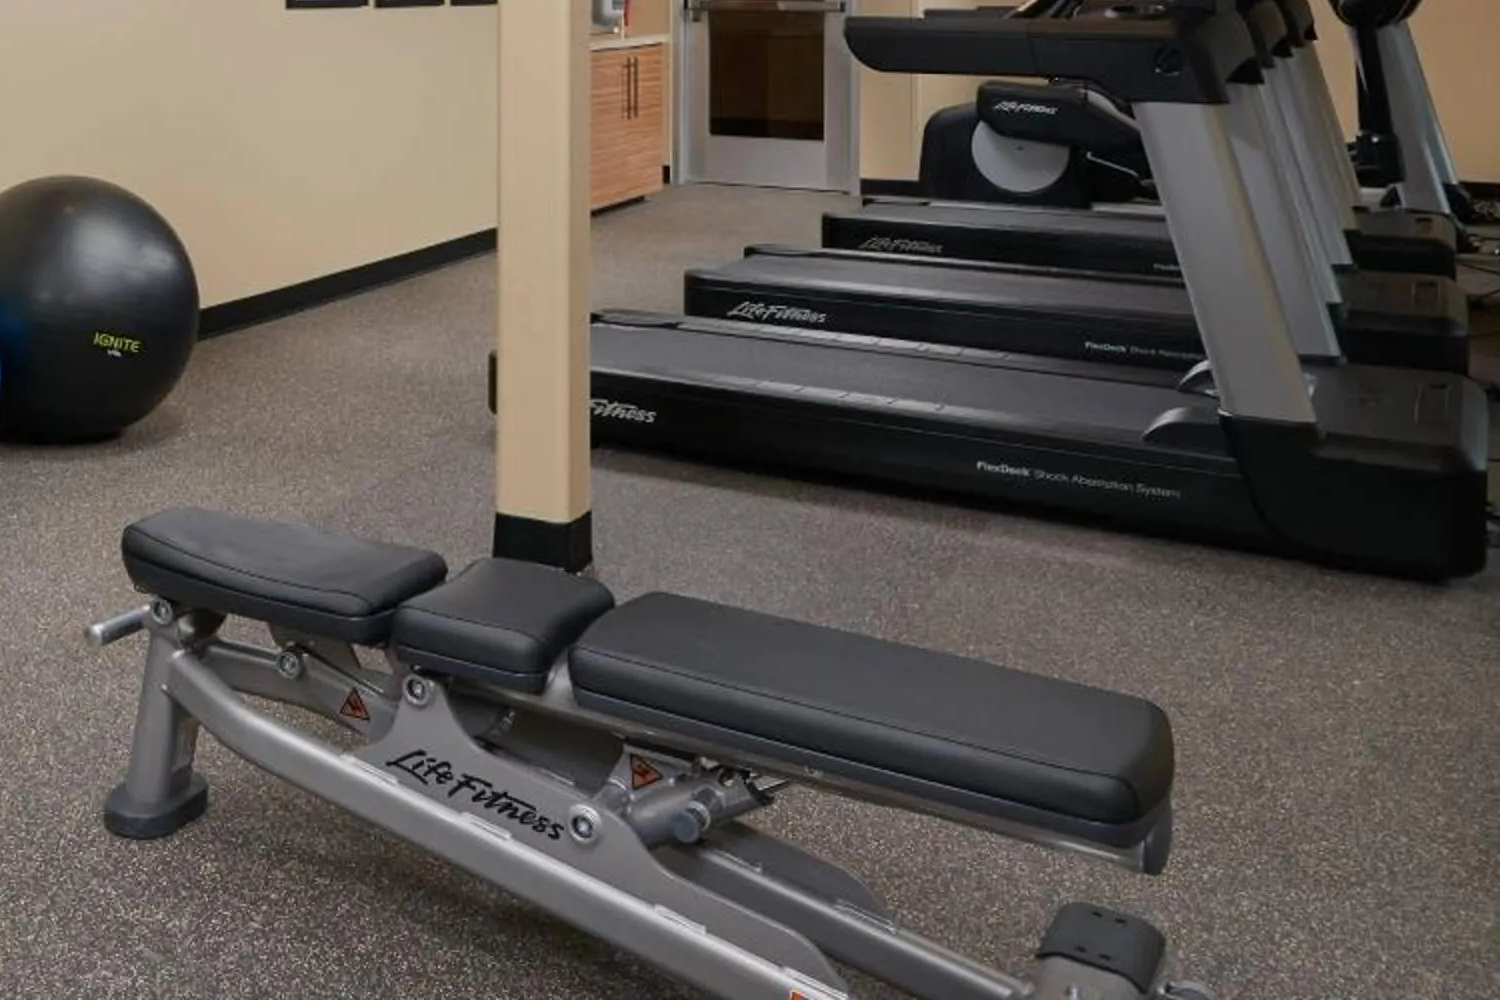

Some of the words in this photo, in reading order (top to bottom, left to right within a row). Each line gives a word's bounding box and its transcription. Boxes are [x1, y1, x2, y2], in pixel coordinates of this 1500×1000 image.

[760, 305, 826, 322] Fitness
[93, 331, 141, 353] IGNITE
[1136, 482, 1181, 499] System
[386, 749, 454, 786] Life
[448, 773, 565, 841] Fitness
